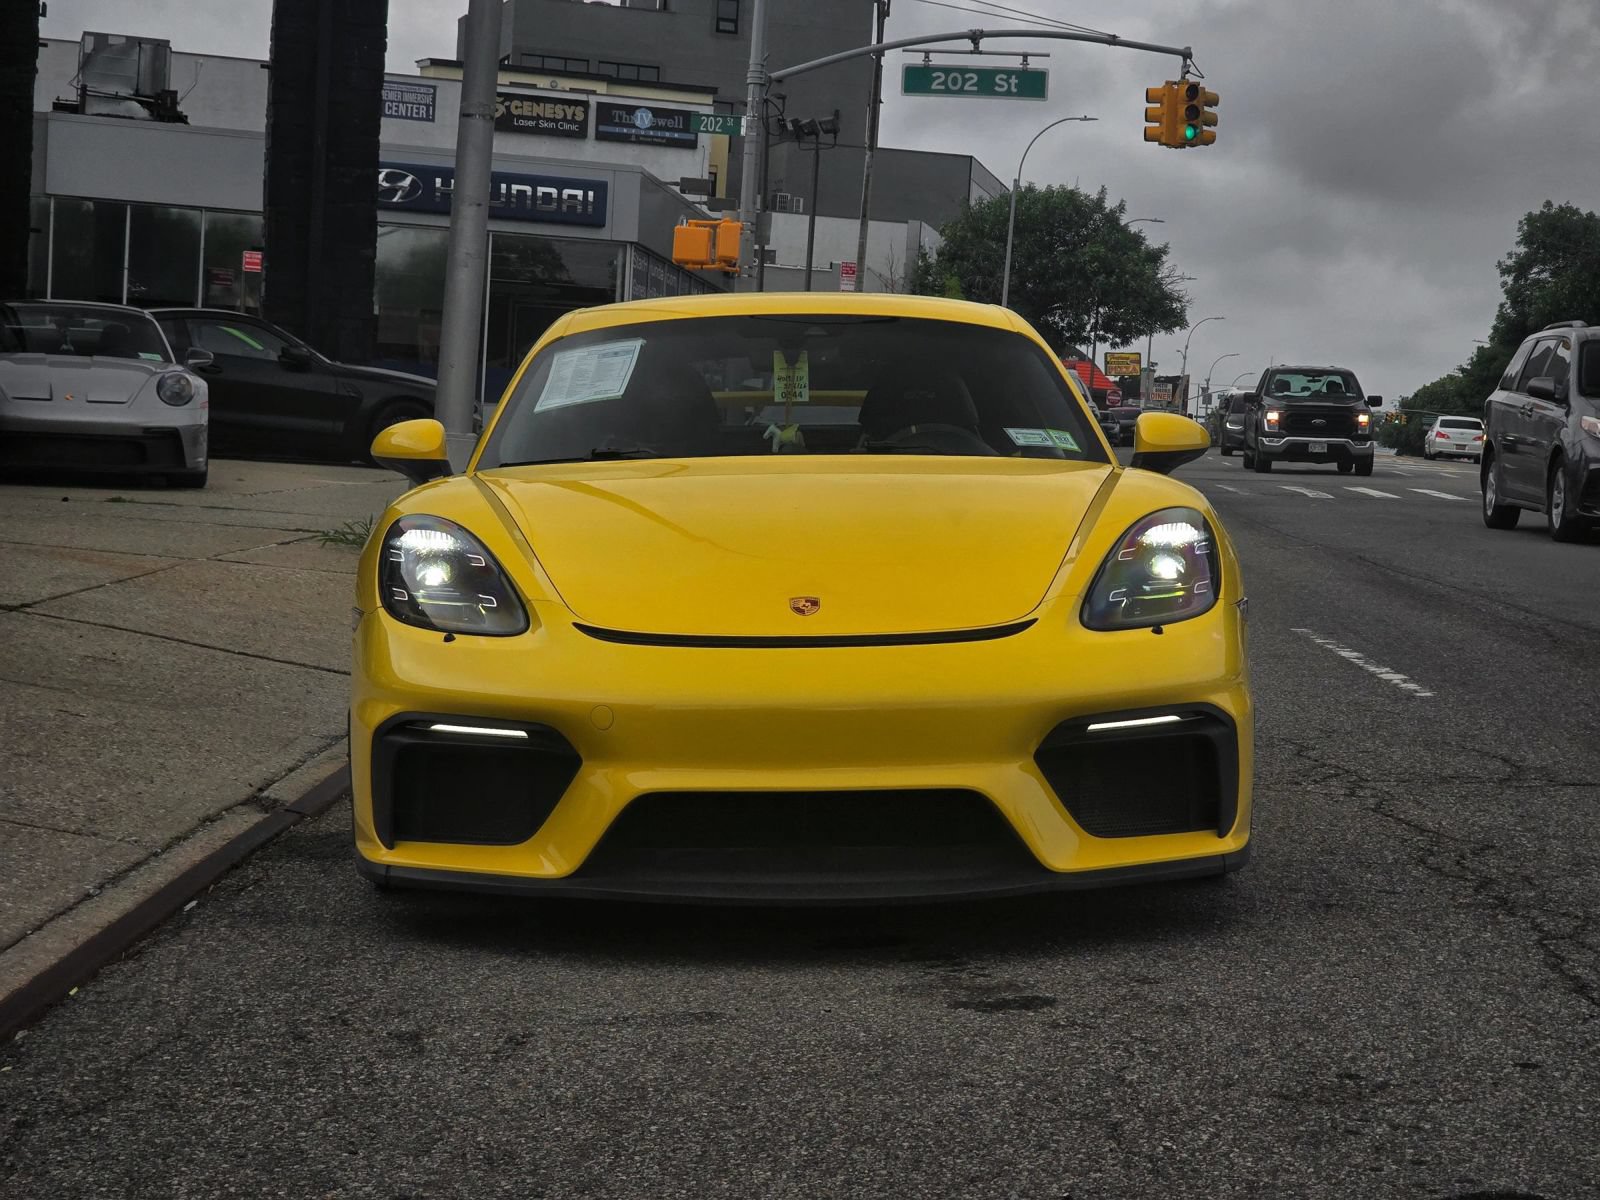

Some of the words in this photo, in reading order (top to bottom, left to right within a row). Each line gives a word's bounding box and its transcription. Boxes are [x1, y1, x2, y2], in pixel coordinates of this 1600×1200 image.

[931, 72, 978, 91] 202
[993, 73, 1019, 93] St
[385, 101, 427, 118] CENTER
[510, 100, 585, 122] GENESYS
[513, 117, 536, 127] Laser
[538, 119, 556, 129] Skin
[557, 121, 580, 131] Clinic
[700, 115, 723, 132] 202
[435, 177, 594, 214] HUNDAI
[1151, 392, 1171, 400] DINER
